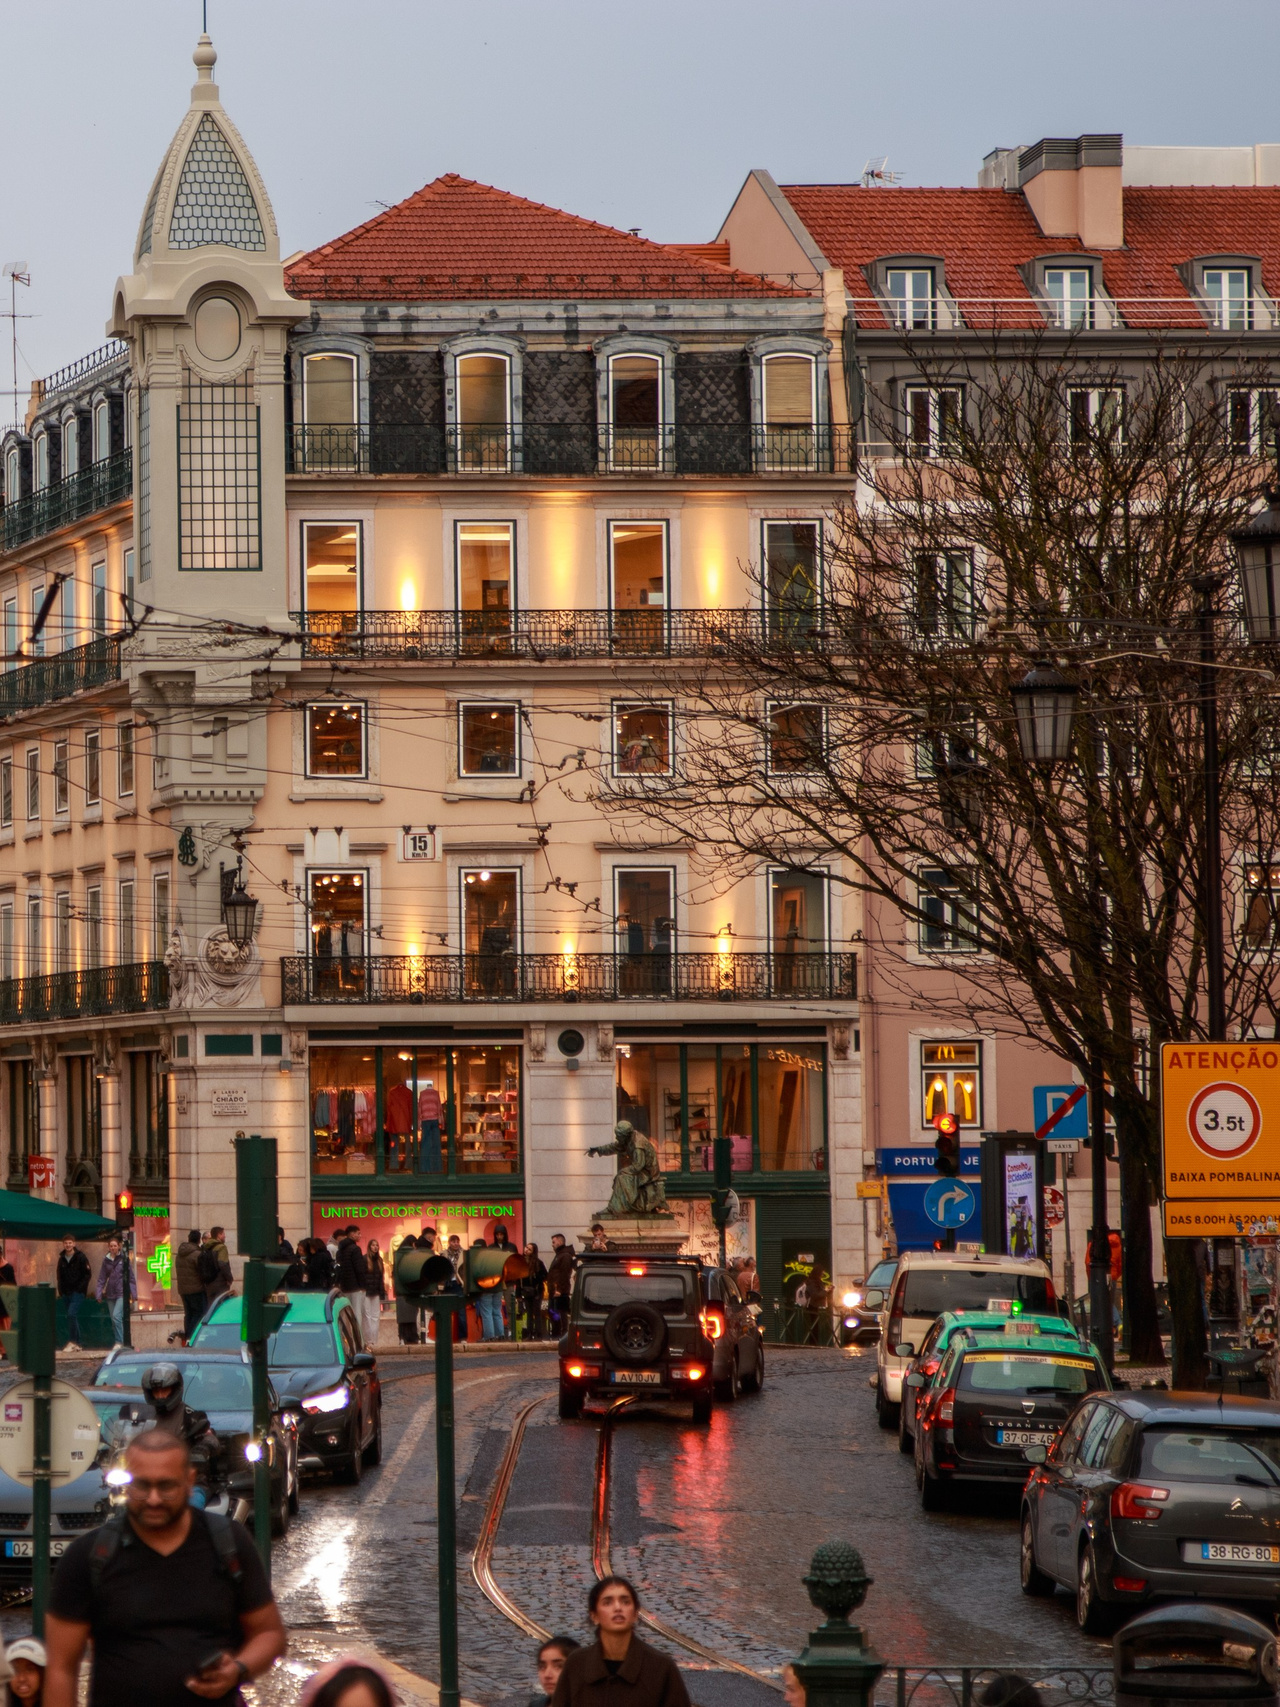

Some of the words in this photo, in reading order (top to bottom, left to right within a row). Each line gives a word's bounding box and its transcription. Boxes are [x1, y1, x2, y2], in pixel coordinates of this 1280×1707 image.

[410, 835, 428, 852] 15
[1168, 1047, 1279, 1074] ATENÇÃO
[1046, 1091, 1075, 1133] P
[1170, 1172, 1206, 1182] BAIXA
[1209, 1172, 1280, 1182] POMBALINA
[321, 1207, 369, 1218] UNITED
[371, 1206, 423, 1218] COLORS
[426, 1206, 443, 1217] OF
[1170, 1215, 1192, 1225] DAS
[1194, 1215, 1226, 1225] 8.00H
[1017, 1323, 1034, 1331] TAXI
[989, 1421, 1032, 1429] LOGAN
